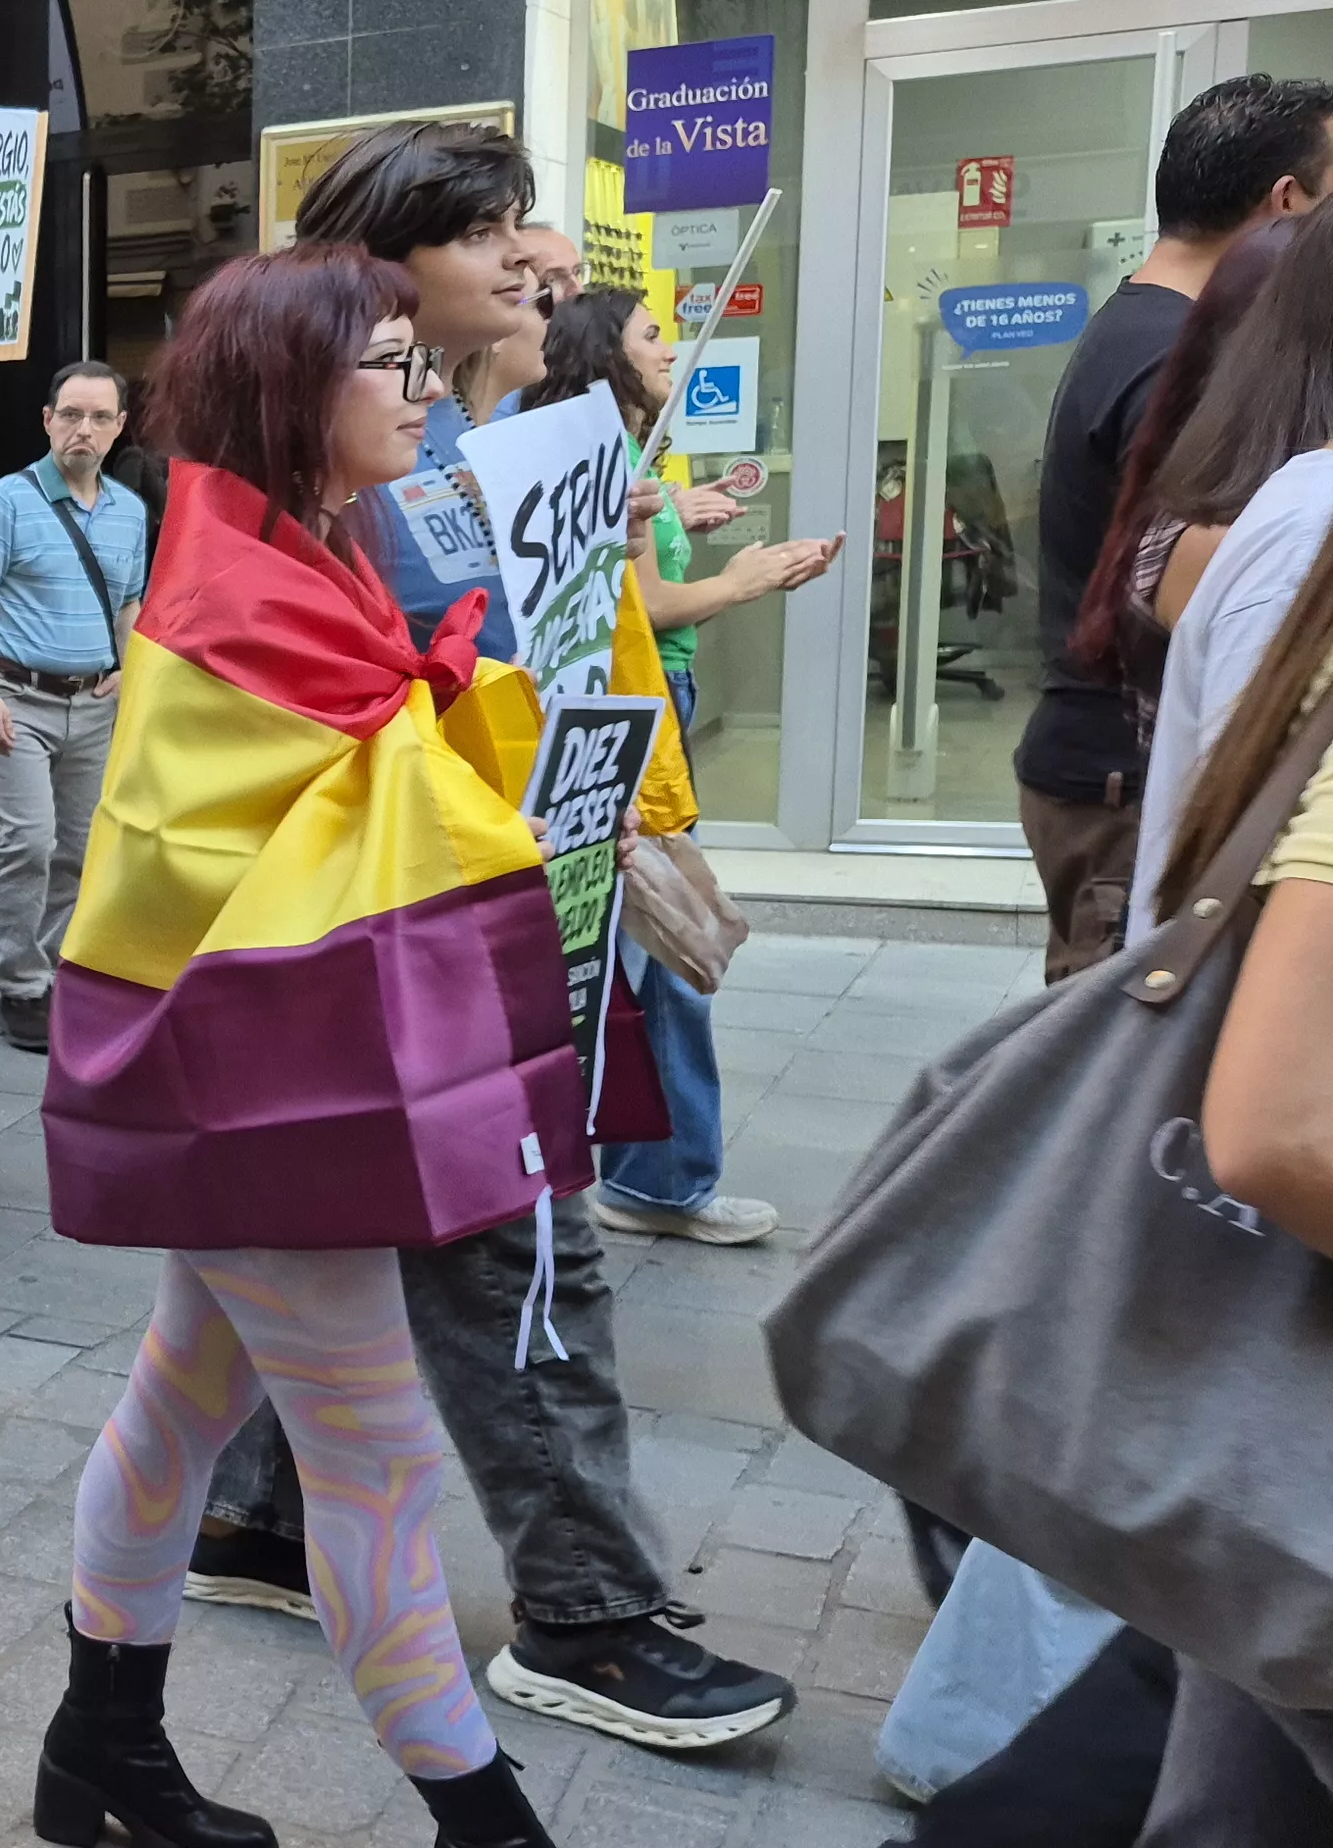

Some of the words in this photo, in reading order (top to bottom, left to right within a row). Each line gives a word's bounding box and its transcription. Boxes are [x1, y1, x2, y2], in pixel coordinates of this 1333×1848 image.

[627, 75, 769, 112] Graduación
[626, 139, 651, 159] de
[655, 136, 673, 156] la
[670, 114, 769, 154] Vista
[682, 302, 712, 315] free
[953, 296, 1016, 316] ¿TIENES
[1017, 292, 1077, 308] MENOS
[965, 314, 986, 329] DE
[989, 314, 1009, 326] 16
[1010, 308, 1063, 325] AÑOS?
[549, 719, 632, 805] DIEZ
